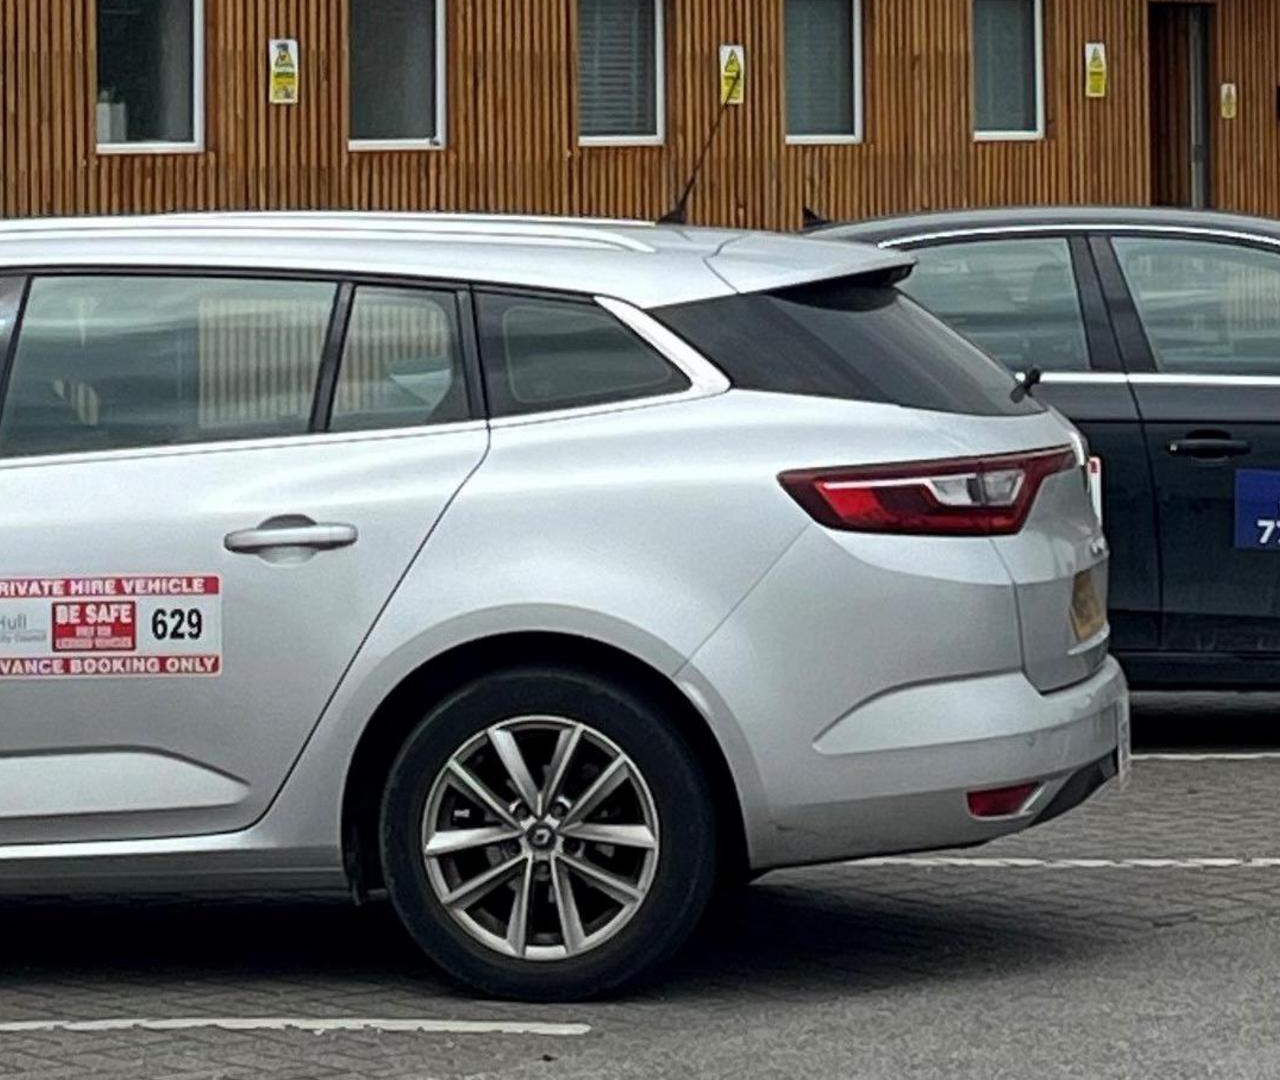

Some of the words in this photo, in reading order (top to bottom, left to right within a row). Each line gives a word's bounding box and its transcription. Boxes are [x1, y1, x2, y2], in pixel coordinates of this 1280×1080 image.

[70, 579, 117, 595] HIRE
[122, 578, 205, 595] VEHICLE
[55, 605, 80, 624] BE
[85, 604, 132, 624] SAFE
[151, 608, 202, 640] 629
[70, 658, 160, 674] BOOKING
[166, 657, 216, 674] ONLY
